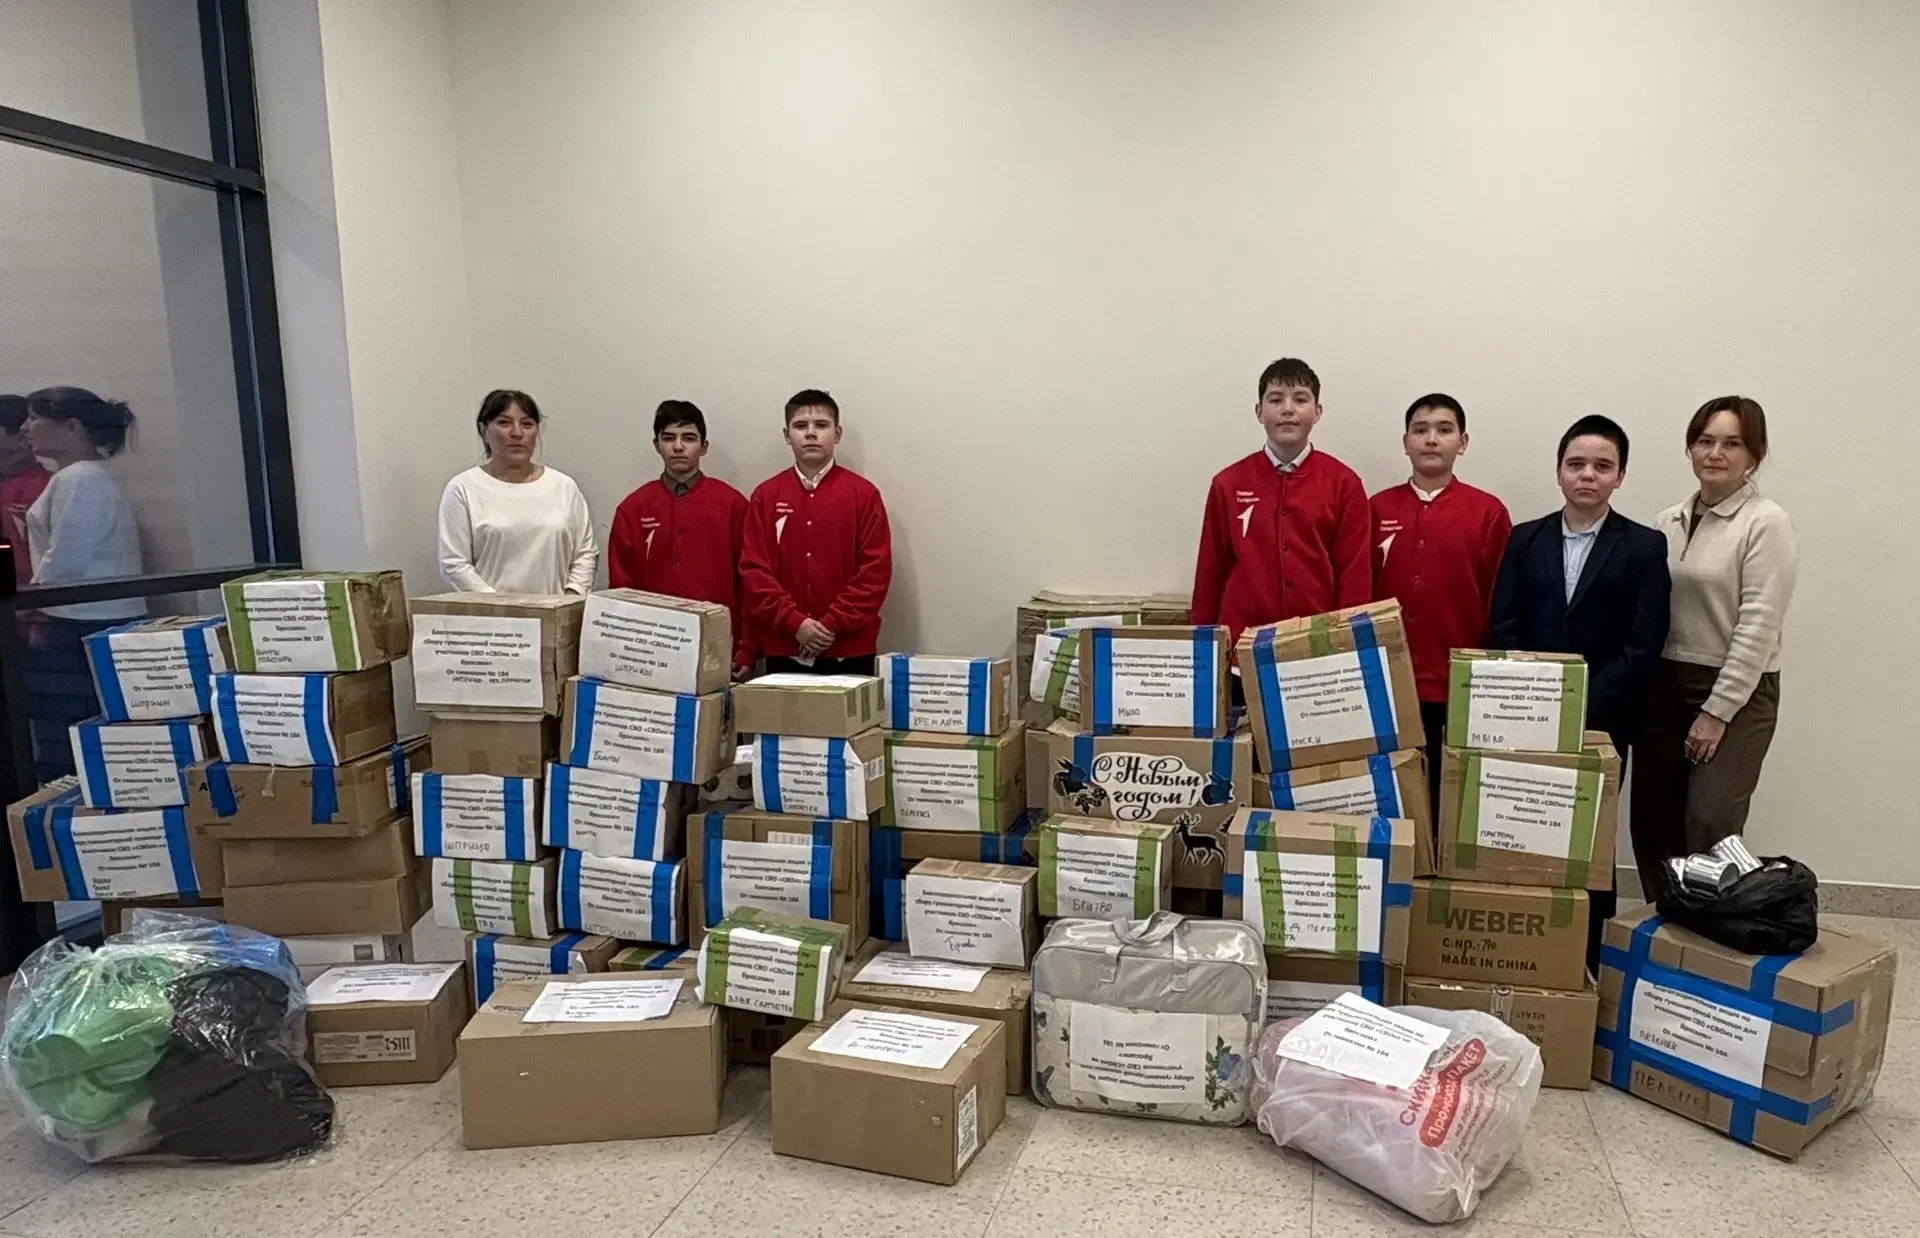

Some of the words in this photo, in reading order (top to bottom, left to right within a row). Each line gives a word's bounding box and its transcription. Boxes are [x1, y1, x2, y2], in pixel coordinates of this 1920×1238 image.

[1113, 756, 1202, 787] Новым
[1113, 790, 1184, 821] годом
[1443, 908, 1546, 936] WEBER
[1441, 954, 1477, 967] MADE
[1480, 957, 1493, 968] IN
[1497, 959, 1538, 972] CHINA
